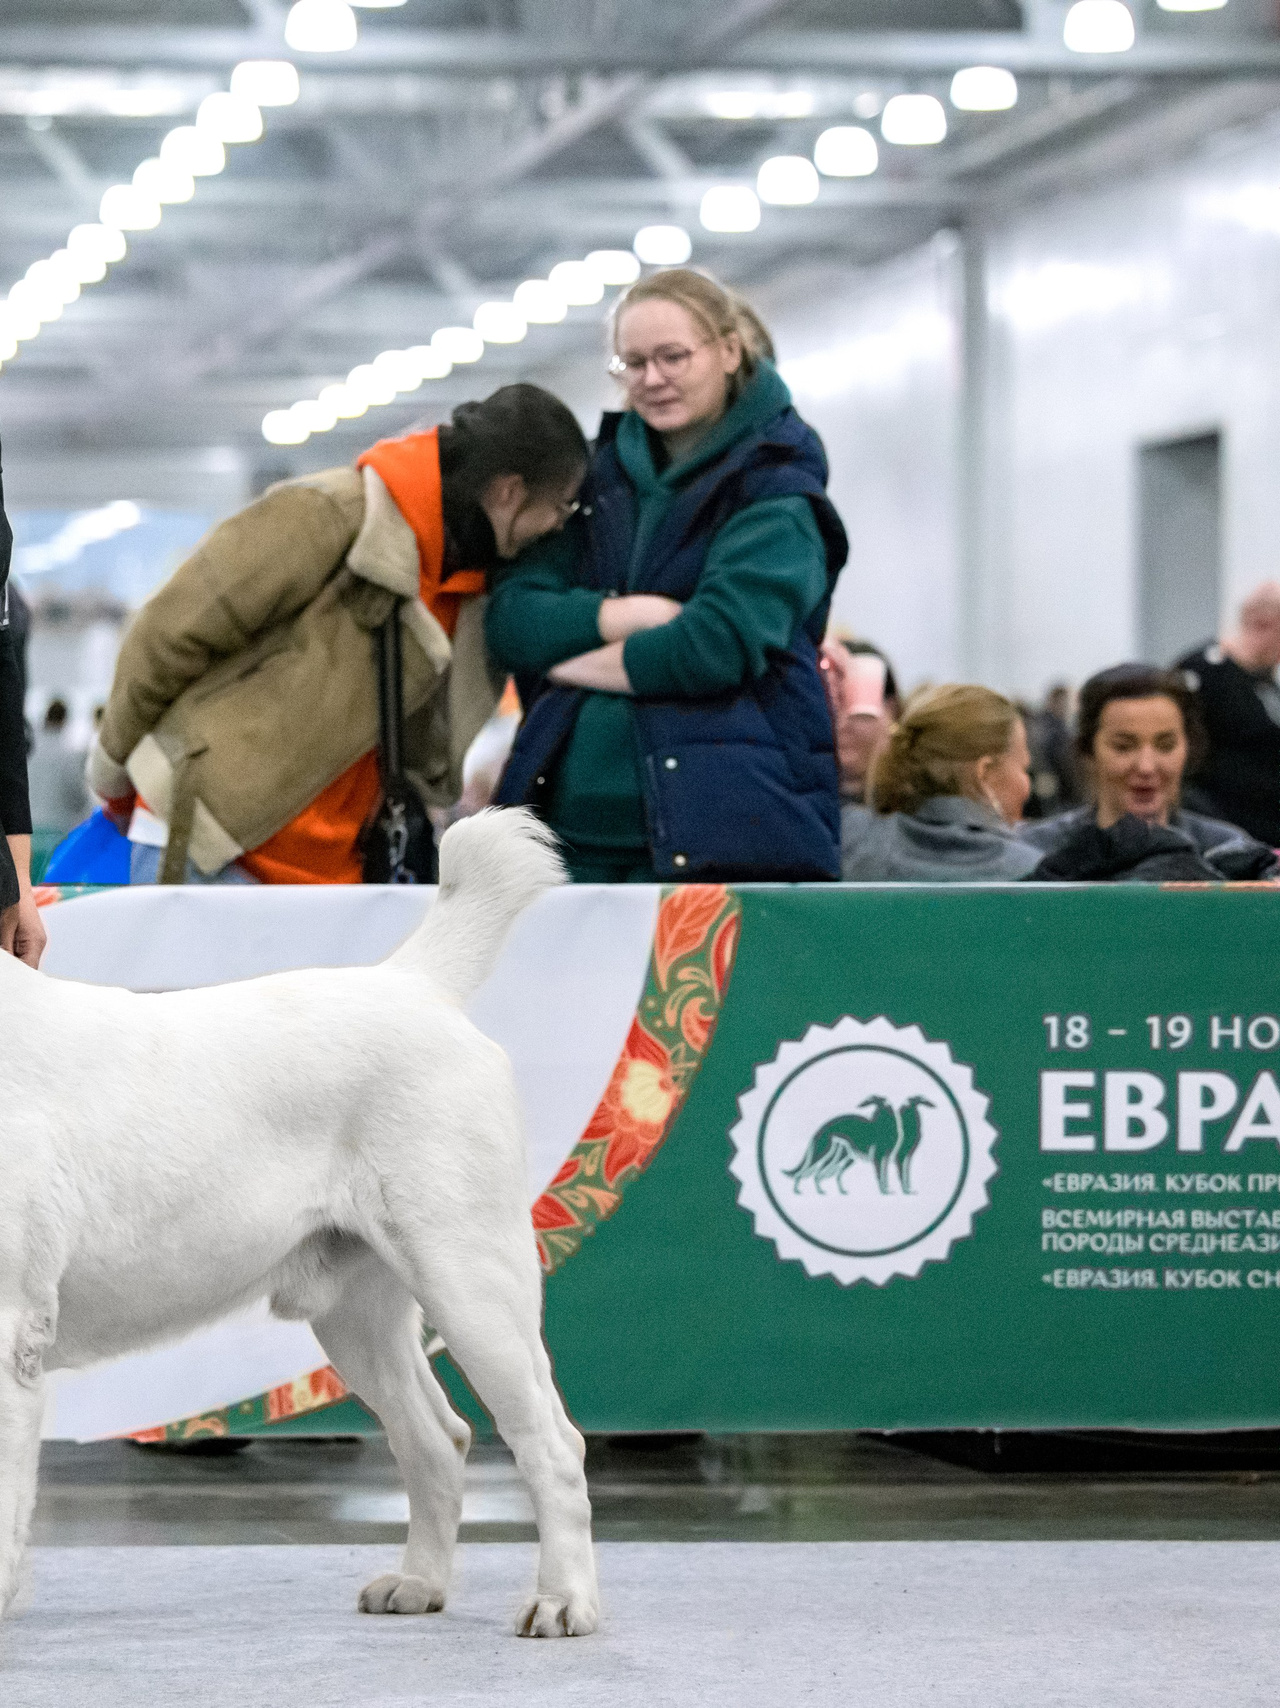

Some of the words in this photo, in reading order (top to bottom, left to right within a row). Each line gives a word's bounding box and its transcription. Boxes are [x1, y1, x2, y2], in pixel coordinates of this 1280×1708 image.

[1043, 1015, 1089, 1049] 18
[1145, 1015, 1192, 1049] 19
[1040, 1070, 1280, 1152] ЕВРА
[1165, 1173, 1241, 1193] КУБОК
[1247, 1173, 1280, 1192] ПР
[1041, 1209, 1186, 1229] ВСЕМИРНАЯ
[1041, 1232, 1144, 1254] ПОРОДЫ
[1164, 1268, 1241, 1288] КУБОК
